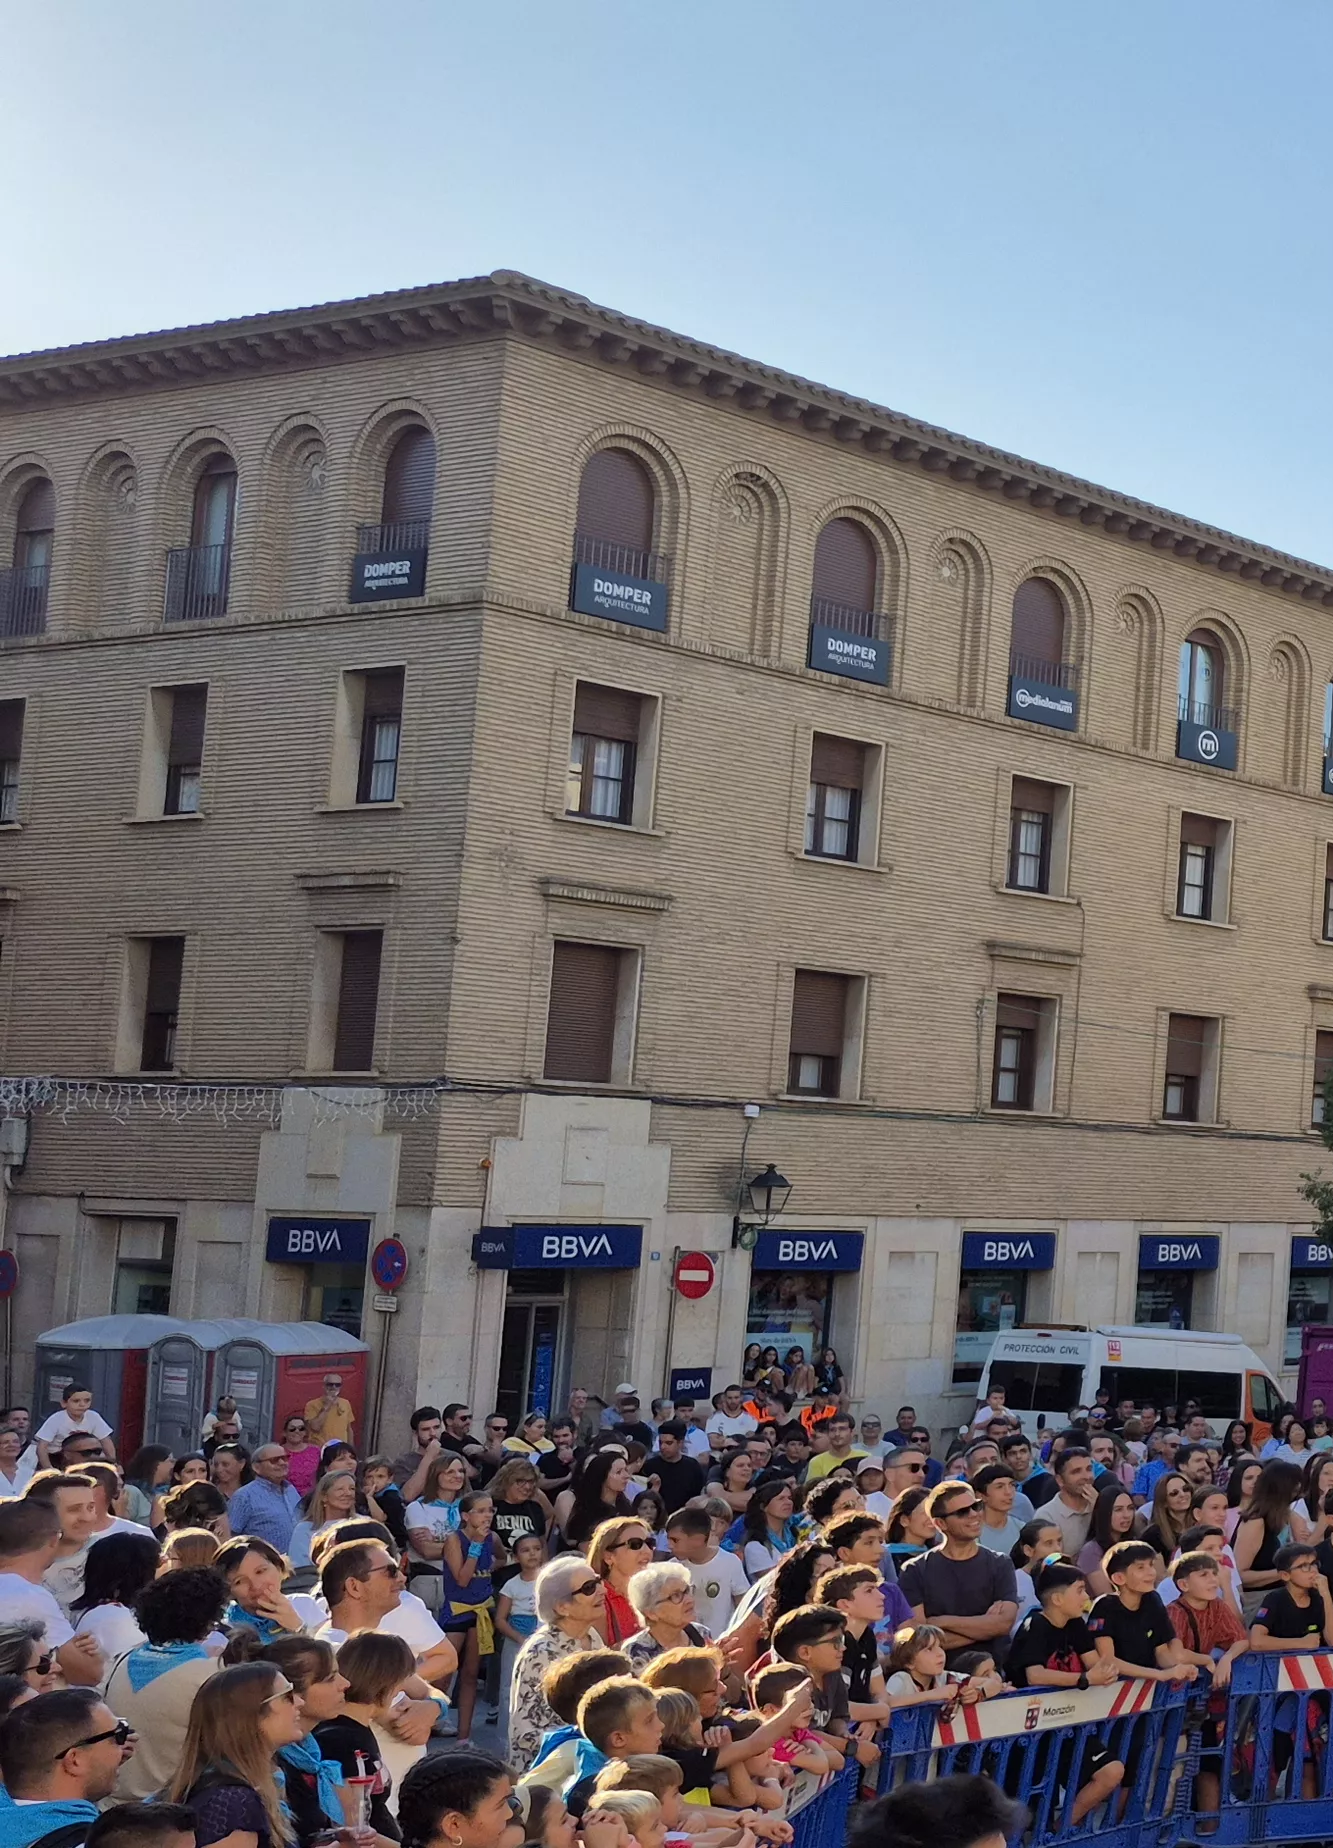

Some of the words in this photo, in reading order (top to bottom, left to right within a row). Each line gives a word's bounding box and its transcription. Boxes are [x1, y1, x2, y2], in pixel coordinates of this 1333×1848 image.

[364, 560, 411, 578] DOMPER
[593, 578, 652, 605] DOMPER
[594, 595, 649, 615] ARQUITECTURA
[827, 637, 876, 661] DOMPER
[287, 1228, 342, 1253] BBVA
[481, 1241, 506, 1253] BBVA
[542, 1233, 613, 1259] BBVA
[778, 1239, 838, 1262] BBVA
[983, 1240, 1035, 1261] BBVA
[1158, 1243, 1202, 1262] BBVA
[1003, 1342, 1056, 1355] PROTECCIÓN
[1059, 1345, 1080, 1355] CIVIL
[676, 1379, 705, 1390] BBVA
[1043, 1704, 1076, 1716] Monzón
